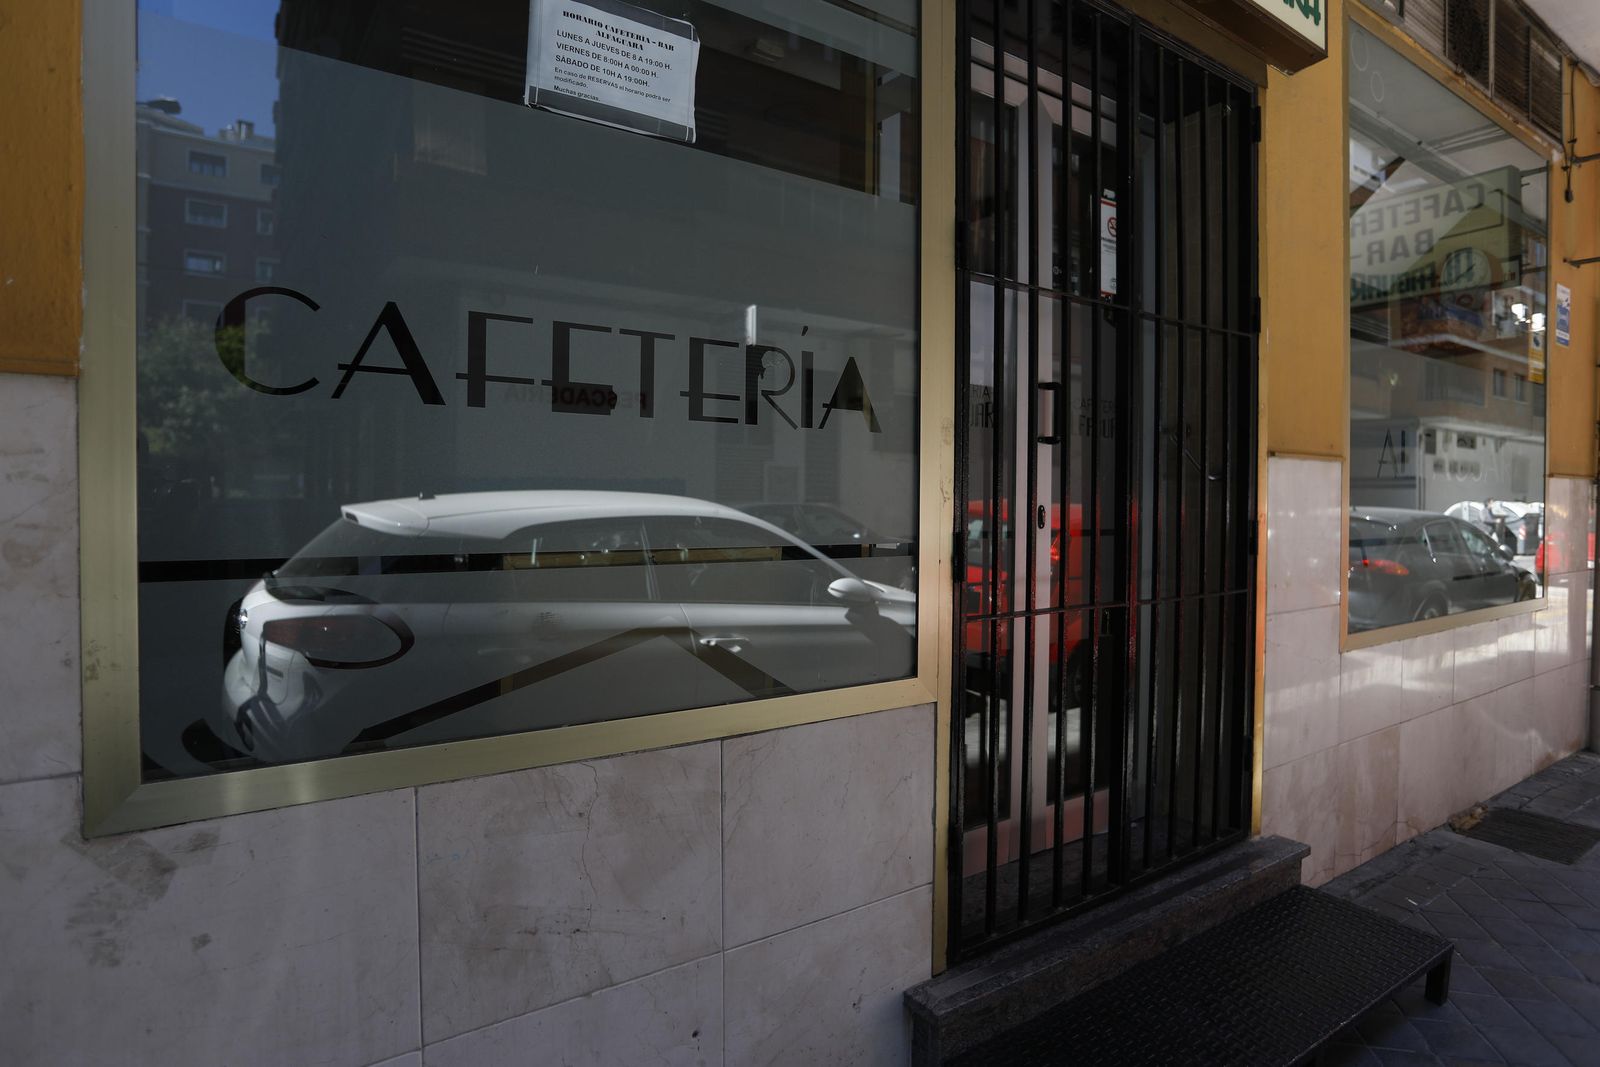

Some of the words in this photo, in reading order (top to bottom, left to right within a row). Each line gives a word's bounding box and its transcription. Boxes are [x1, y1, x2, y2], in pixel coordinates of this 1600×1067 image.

[563, 10, 603, 28] HORARIO
[658, 42, 674, 51] BAR
[596, 30, 644, 50] ALFAGUARA
[556, 42, 590, 57] VIERNES
[592, 53, 601, 61] DE
[603, 55, 623, 68] 8:00H
[631, 65, 650, 76] 00:00
[557, 30, 583, 42] LUNES
[592, 39, 620, 54] JUEVES
[621, 50, 631, 59] DE
[645, 58, 663, 68] 19:00
[556, 55, 588, 69] SÁBADO
[603, 68, 616, 76] 10H
[554, 76, 588, 88] modificado.
[588, 75, 618, 89] RESERVAS
[624, 86, 644, 97] horario
[554, 85, 576, 96] Muchas
[578, 91, 601, 102] gracias.
[215, 286, 880, 433] CAFETERÍA
